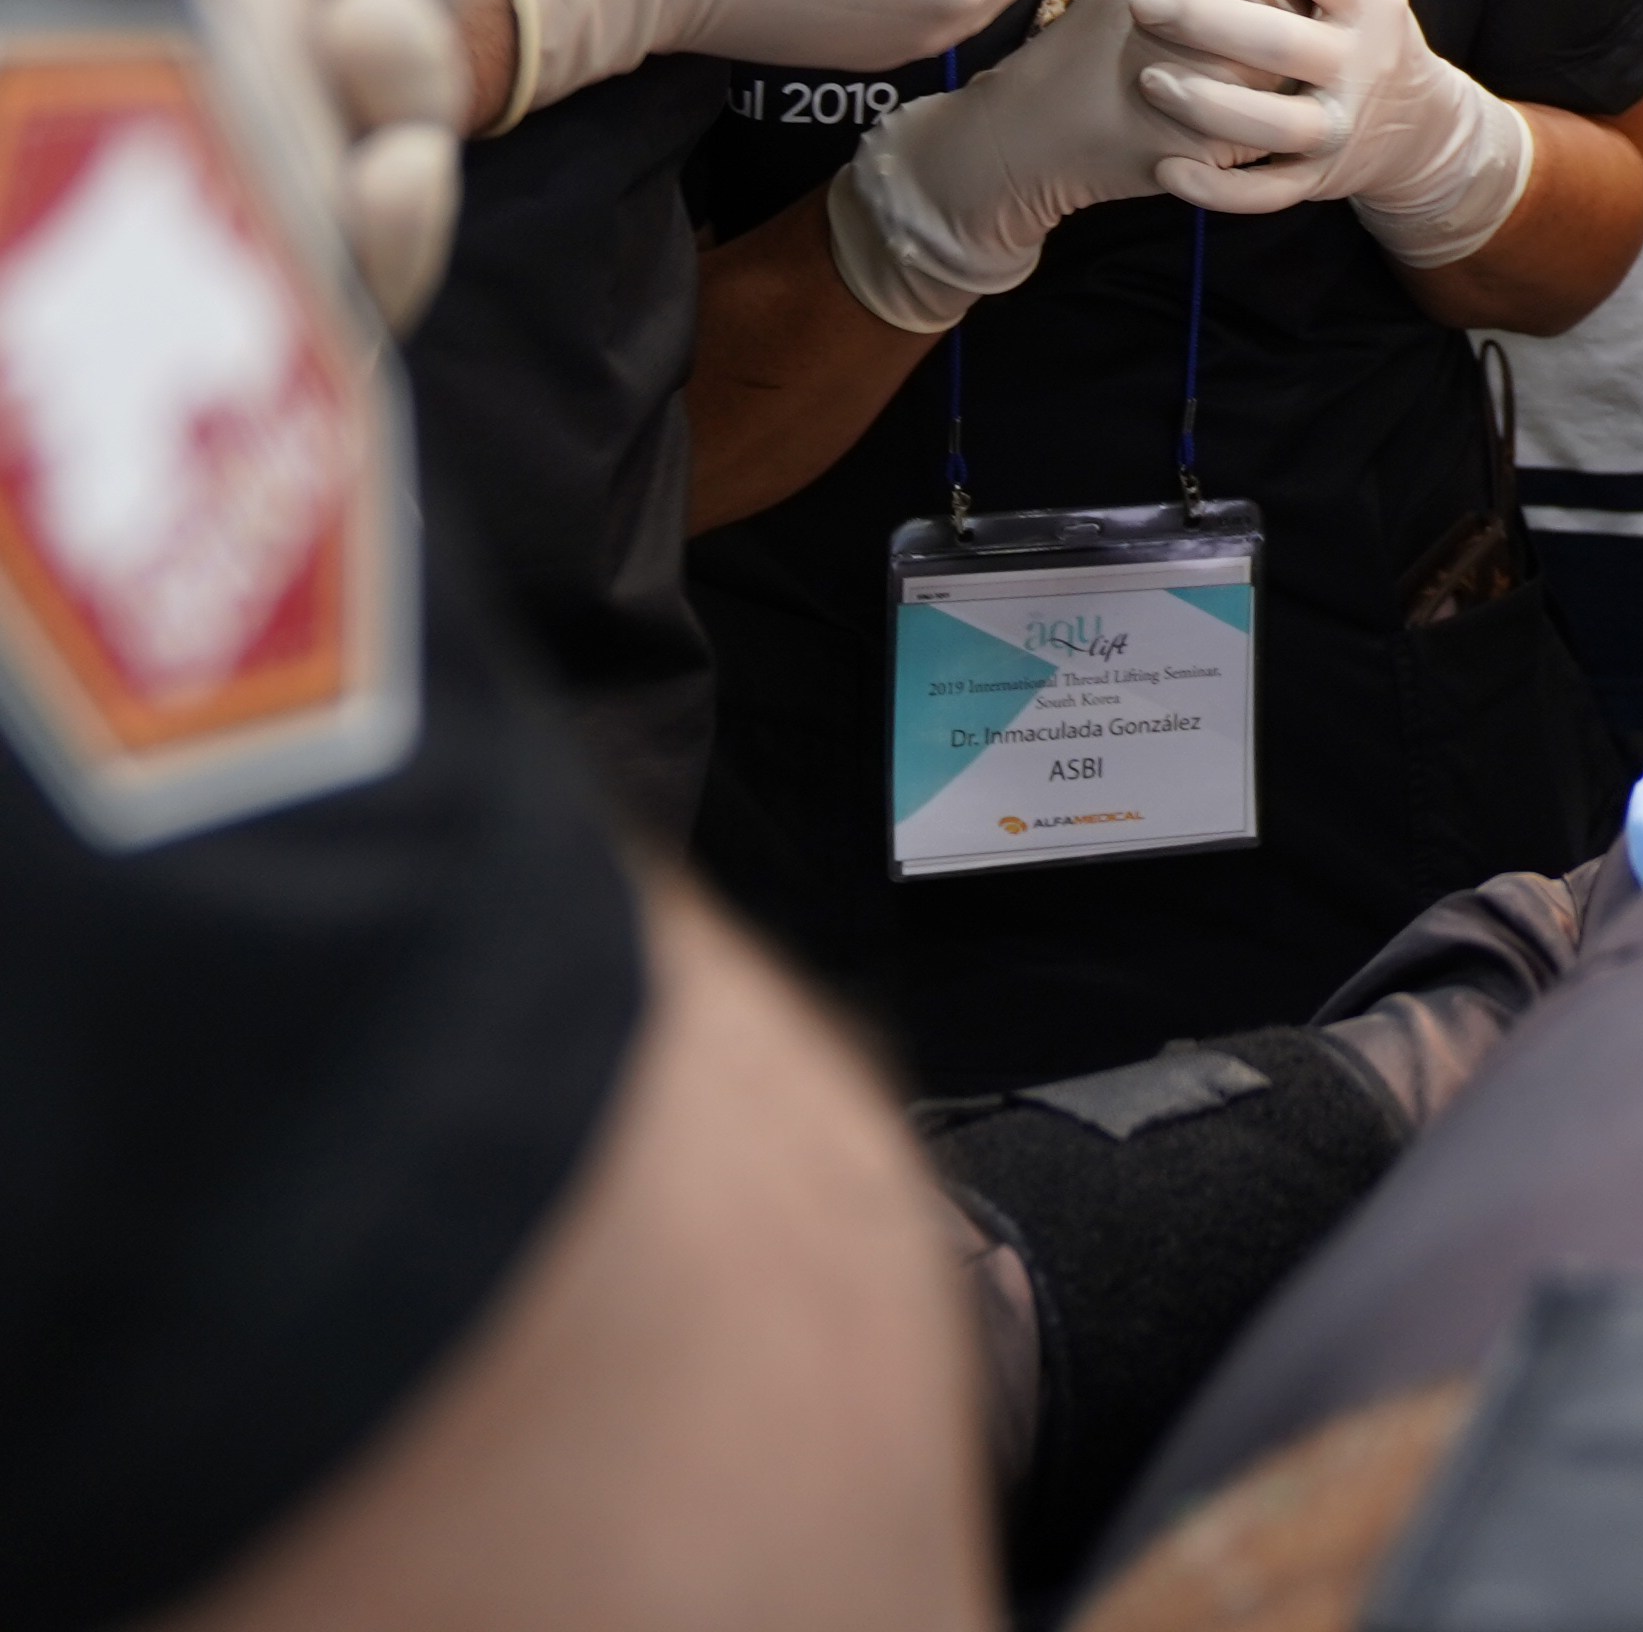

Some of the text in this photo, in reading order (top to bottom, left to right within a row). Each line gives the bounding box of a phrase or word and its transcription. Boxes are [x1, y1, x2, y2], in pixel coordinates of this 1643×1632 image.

[780, 81, 899, 125] 2019
[928, 680, 965, 697] 2019
[969, 674, 1058, 694] International
[1063, 671, 1109, 687] Thread
[1114, 668, 1160, 685] Lifting
[1035, 692, 1121, 710] South Korea
[950, 713, 1202, 748] Dr. Inmaculada González
[1048, 757, 1104, 783] ASBI
